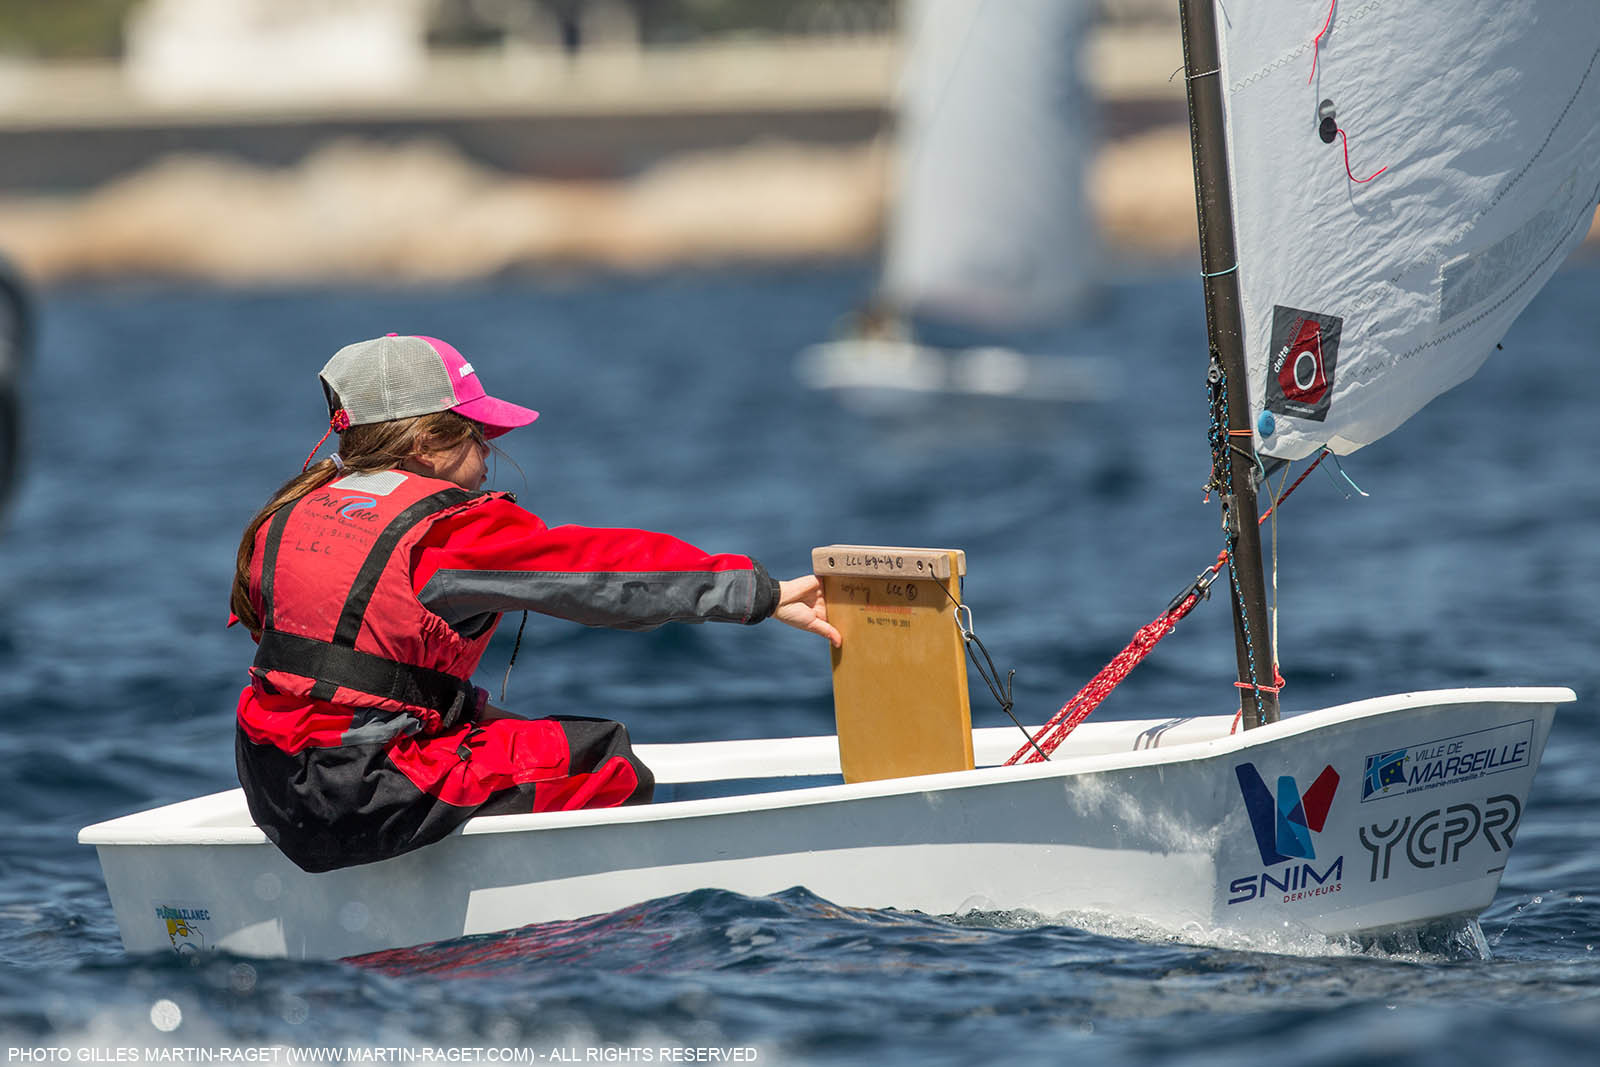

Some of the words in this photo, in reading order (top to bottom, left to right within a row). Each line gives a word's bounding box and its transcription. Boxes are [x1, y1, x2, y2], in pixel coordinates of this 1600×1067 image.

[1408, 741, 1528, 786] MARSEILLE
[1415, 745, 1445, 762] VILLE
[1446, 741, 1464, 755] DE
[1359, 794, 1521, 882] YCPR
[1228, 855, 1344, 905] SNIM
[1283, 883, 1342, 904] DERIVEURS
[155, 907, 210, 920] PLAZLANEC
